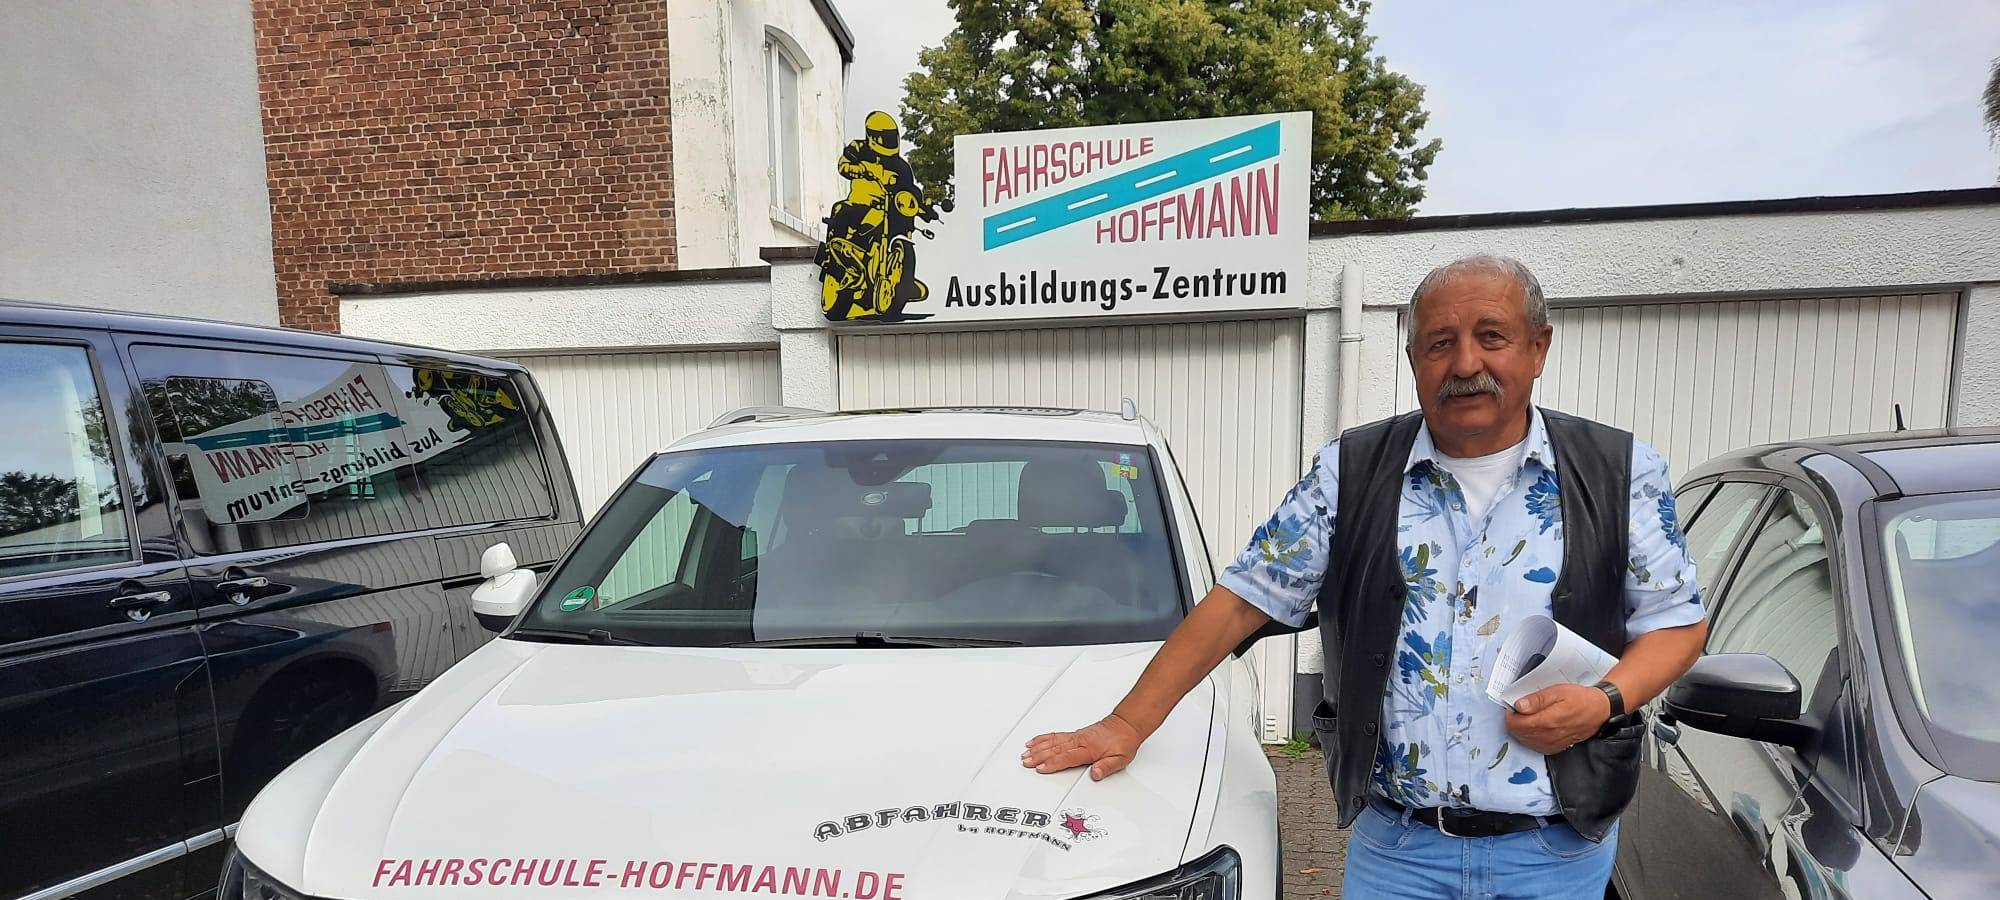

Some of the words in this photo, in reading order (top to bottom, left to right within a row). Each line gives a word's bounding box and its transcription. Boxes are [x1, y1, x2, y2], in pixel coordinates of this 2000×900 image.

[982, 137, 1154, 208] FAHRSCHULE
[1096, 163, 1281, 244] HOFFMANN
[945, 266, 1287, 311] Ausbildungs-Zentrum
[813, 800, 1051, 842] ABFAHRER
[958, 823, 978, 834] by
[985, 826, 1071, 852] HOFFMANN
[372, 858, 905, 900] FAHRSCHULE-HOFFMANN.DE
